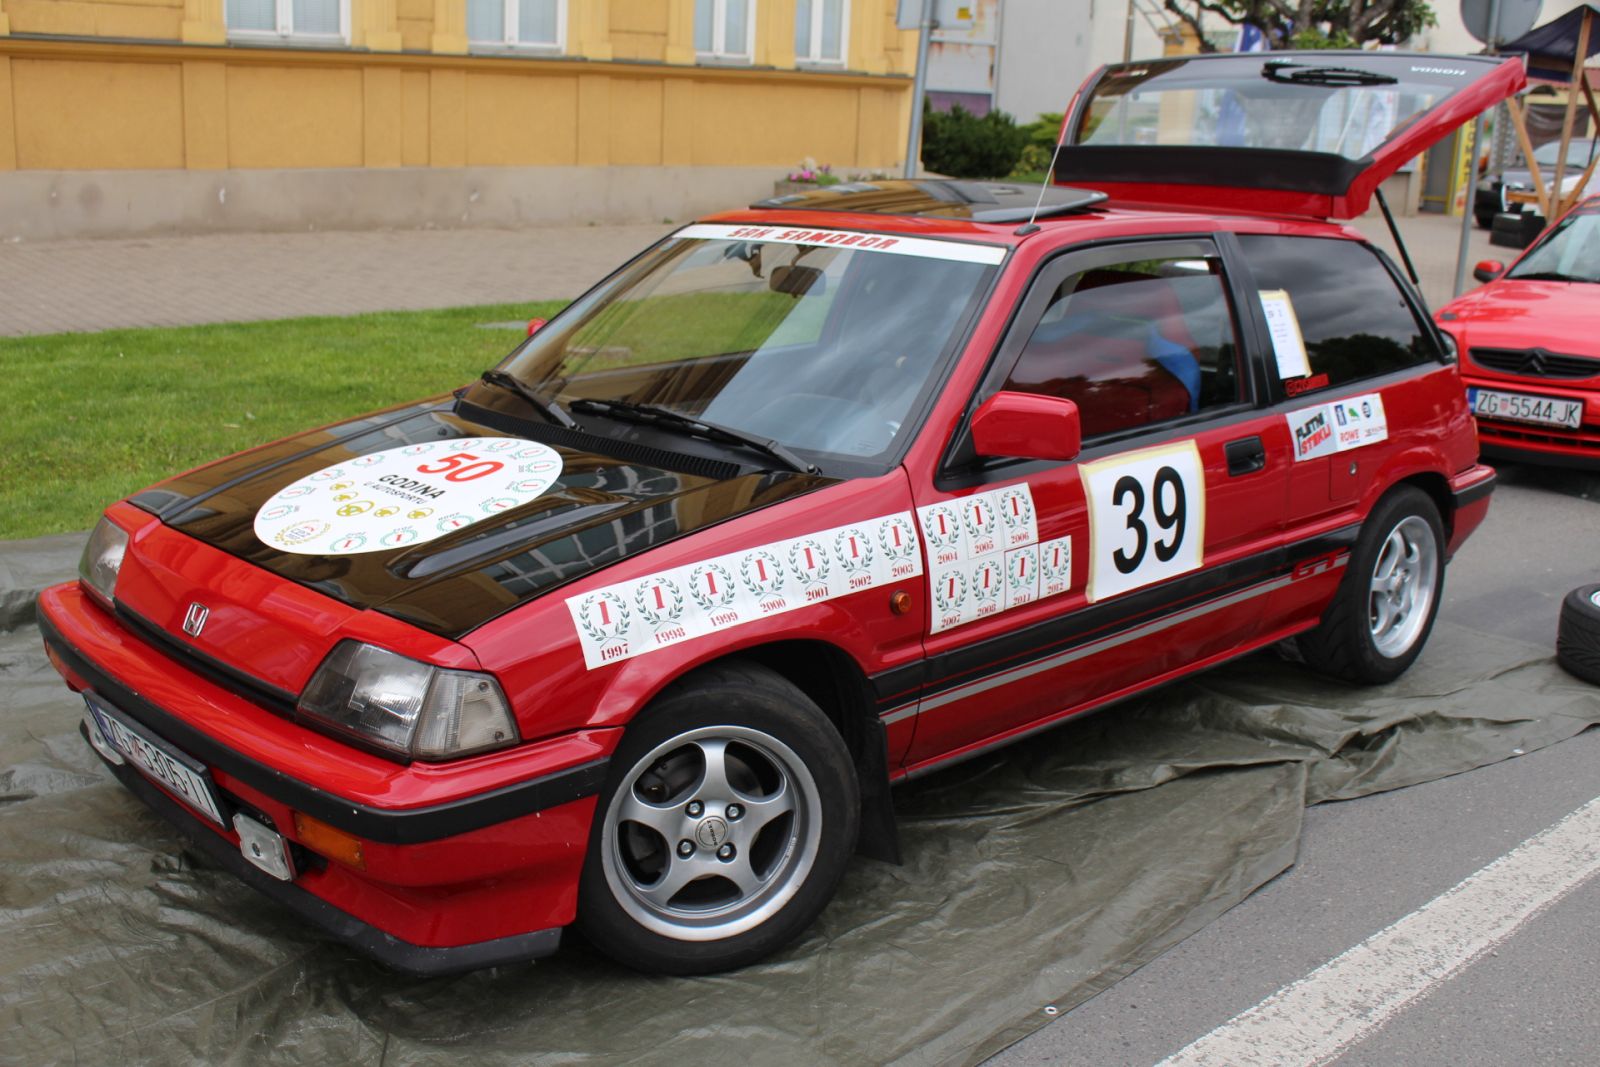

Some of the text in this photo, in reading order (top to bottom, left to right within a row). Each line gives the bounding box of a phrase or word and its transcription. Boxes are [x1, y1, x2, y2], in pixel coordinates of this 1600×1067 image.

[1411, 65, 1466, 76] HONDA
[775, 230, 900, 249] SAMOBOR
[1477, 392, 1580, 425] ZG 5544-JK
[417, 452, 505, 483] 50
[378, 474, 447, 499] GODINA
[974, 505, 983, 526] 1
[1011, 496, 1020, 517] 1
[938, 514, 947, 535] 1
[1112, 465, 1187, 575] 39
[891, 525, 902, 547] 1
[1011, 532, 1030, 545] 2006
[848, 536, 860, 558] 1
[974, 540, 994, 554] 2005
[1053, 547, 1060, 568] 1
[803, 547, 816, 570] 1
[937, 551, 958, 565] 2004
[1019, 557, 1026, 577] 1
[755, 558, 769, 582] 1
[892, 563, 915, 578] 2003
[983, 568, 990, 589] 1
[705, 572, 718, 596] 1
[849, 575, 873, 590] 2002
[948, 577, 955, 599] 1
[1047, 582, 1064, 595] 2012
[652, 585, 665, 610] 1
[805, 586, 829, 601] 2001
[1013, 592, 1031, 606] 2011
[598, 600, 612, 626] 1
[760, 598, 787, 613] 2000
[977, 603, 997, 617] 2008
[709, 611, 739, 627] 1999
[941, 614, 961, 628] 2007
[655, 626, 686, 644] 1998
[600, 643, 630, 661] 1997
[101, 711, 133, 756] ZG
